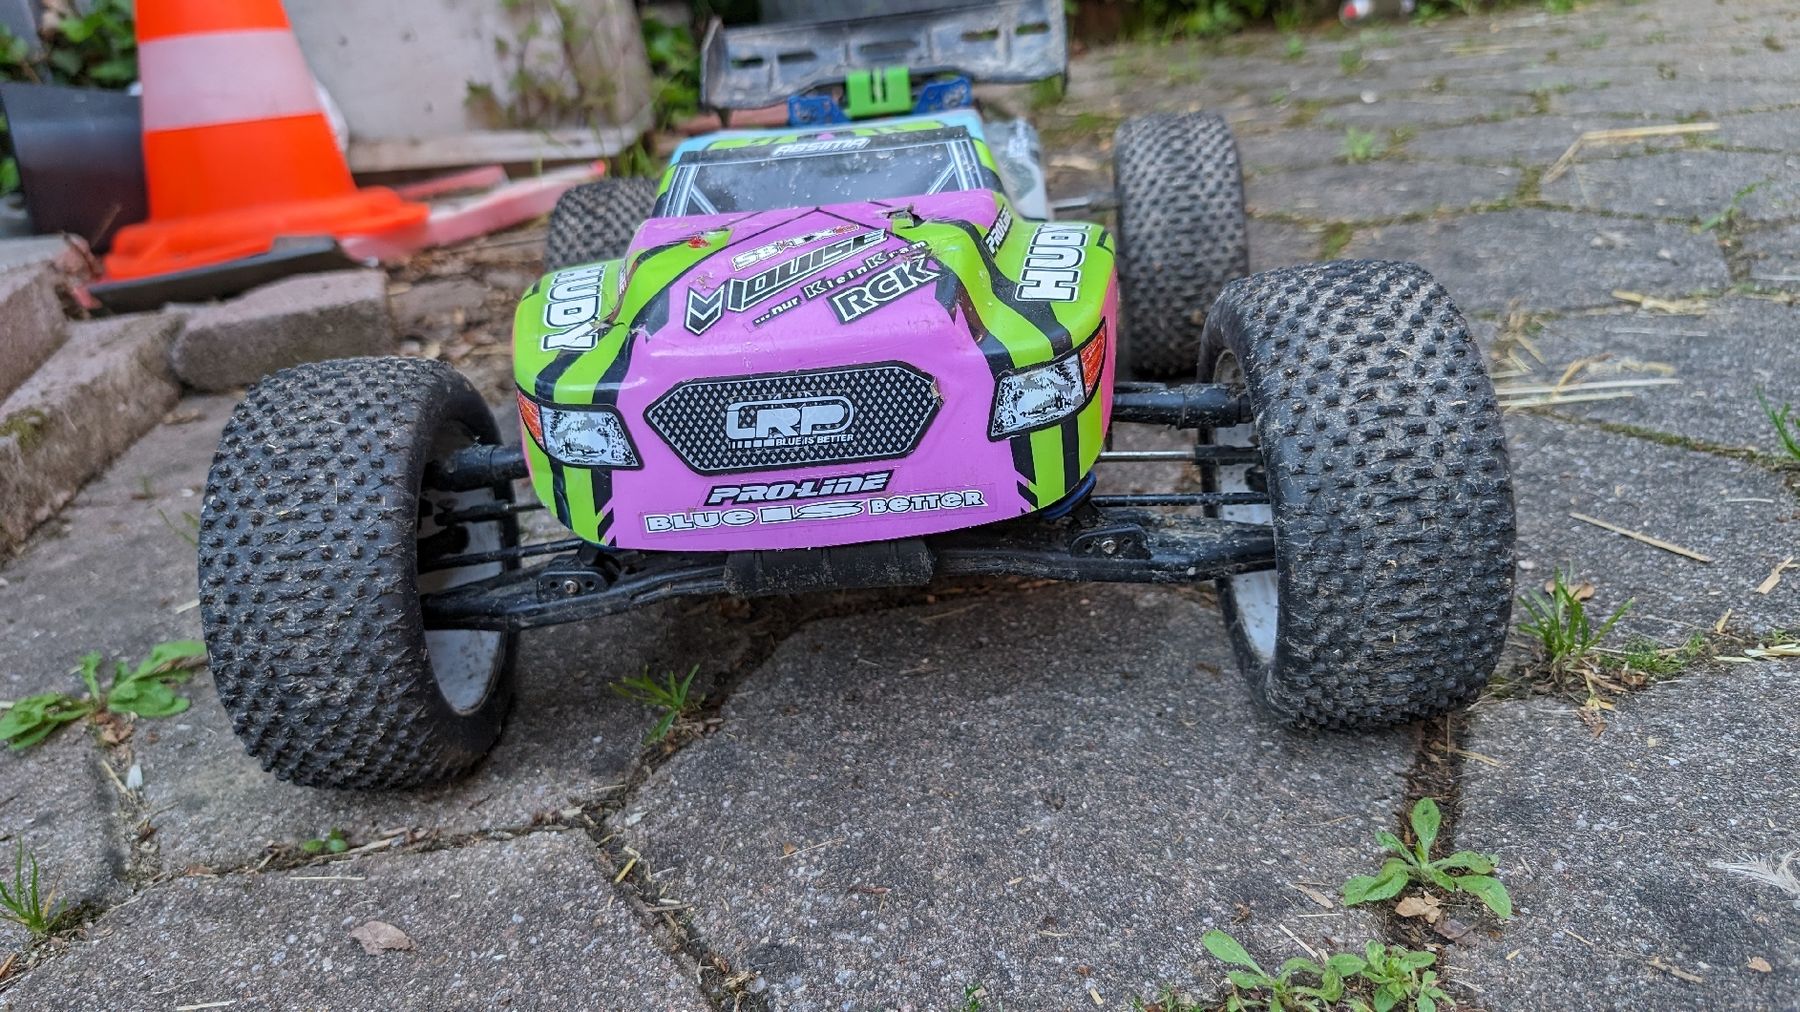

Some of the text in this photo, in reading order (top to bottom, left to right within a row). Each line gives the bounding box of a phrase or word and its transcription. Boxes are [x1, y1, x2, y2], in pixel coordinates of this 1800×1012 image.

[772, 137, 871, 157] ABSIMA
[834, 254, 941, 321] RCK
[543, 264, 605, 350] HUDY
[727, 396, 854, 439] LRP
[776, 433, 854, 447] BLUE IS BETTER
[760, 500, 863, 522] IS
